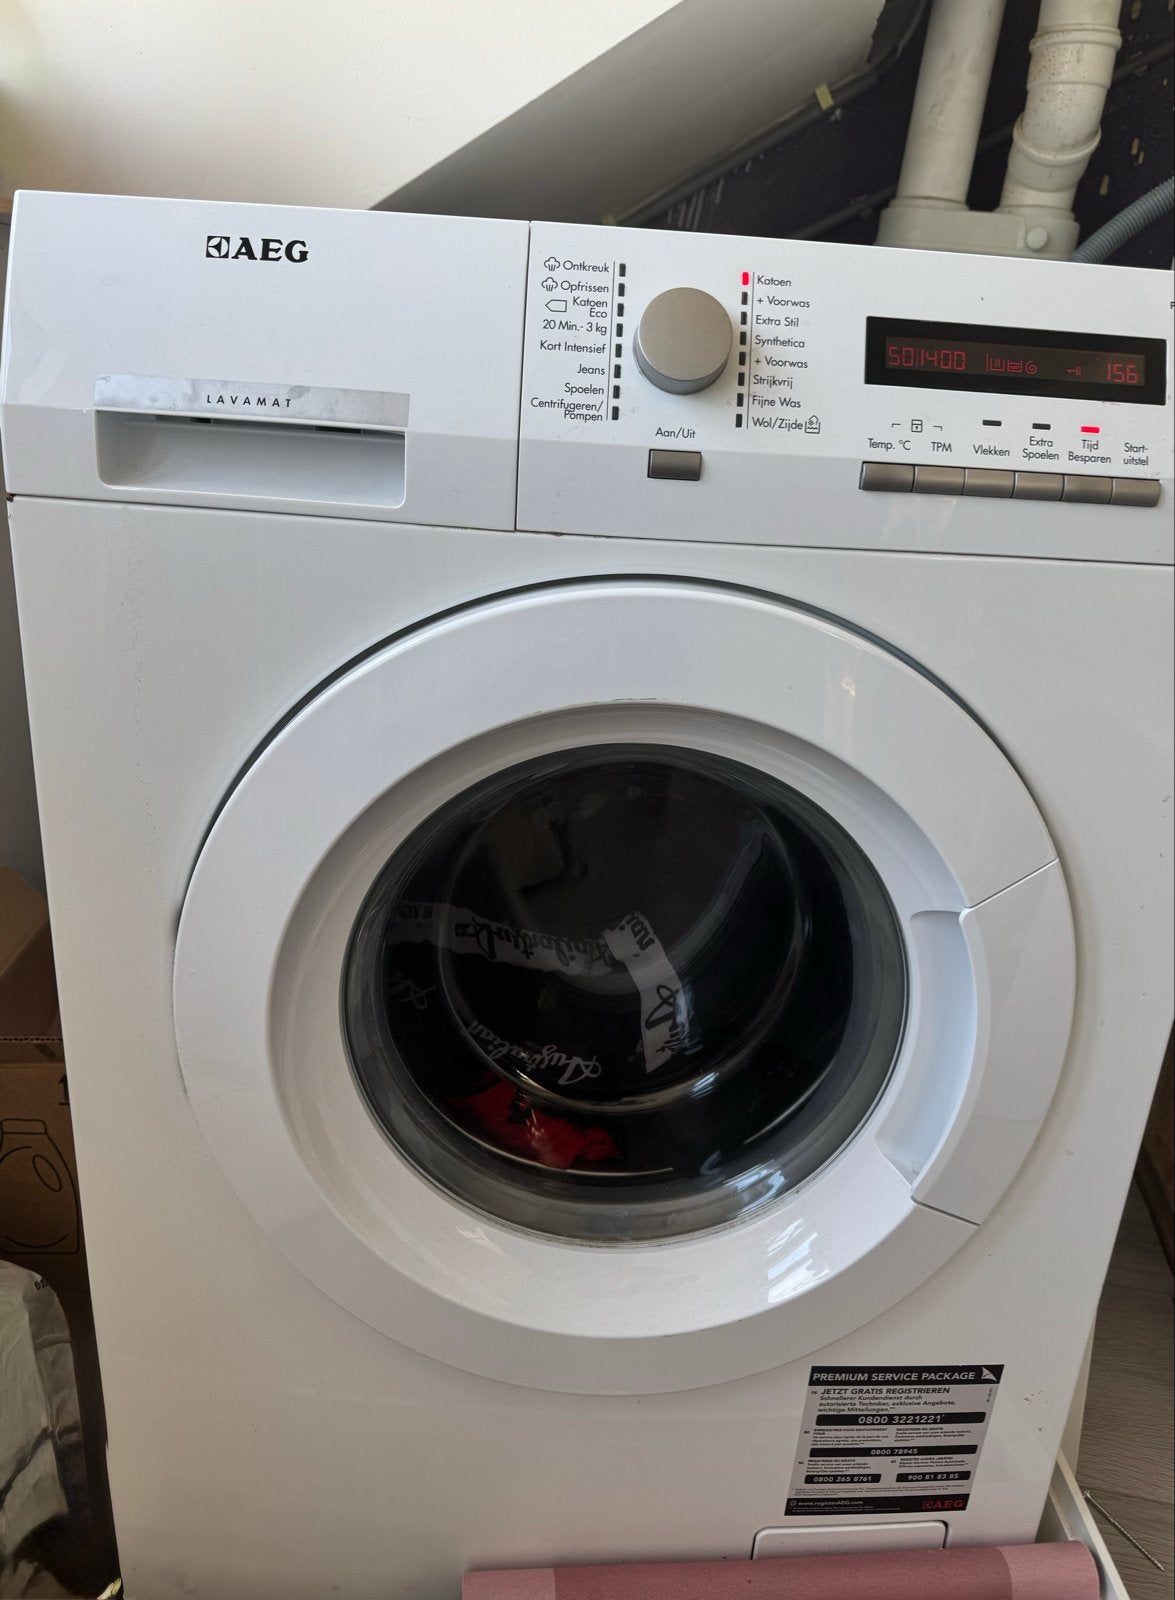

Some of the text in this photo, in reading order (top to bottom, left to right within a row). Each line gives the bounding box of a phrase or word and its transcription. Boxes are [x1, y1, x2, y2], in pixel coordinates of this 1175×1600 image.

[231, 237, 309, 263] AEG
[563, 260, 610, 273] Ontkreuk
[560, 280, 609, 293] Opfrissen
[757, 275, 792, 288] Katoen
[572, 297, 608, 308] Katoen
[767, 296, 811, 308] Voorwas
[589, 308, 608, 318] Eco
[542, 319, 556, 330] 20
[586, 322, 594, 332] 3
[595, 323, 607, 336] kg
[755, 316, 799, 327] Extra Stil
[540, 340, 606, 354] Kort Intensief
[754, 335, 806, 350] Synthetica
[764, 356, 809, 369] Voorwas
[577, 364, 606, 376] Jeans
[1105, 363, 1140, 384] 156
[752, 375, 793, 390] Strijkvrij
[564, 383, 605, 396] Spoelen
[206, 394, 292, 409] LAVAMAT
[530, 397, 604, 412] Centrifugeren/
[752, 395, 802, 409] Fijne Was
[564, 410, 604, 423] Pompen
[752, 417, 803, 432] Wol/Zijde
[655, 427, 696, 440] Aan/Uit
[867, 438, 911, 451] Temp. °C
[931, 442, 952, 453] TPM
[1029, 437, 1053, 448] Extra
[1080, 439, 1099, 452] Tijd
[1124, 443, 1149, 455] Start-
[973, 445, 1010, 457] Vlekken
[1022, 448, 1060, 462] Spoelen
[1068, 451, 1112, 466] Besparen
[1123, 455, 1149, 466] uitstel
[467, 1019, 602, 1086] Australian
[812, 1371, 975, 1382] PREMIUM SERVICE PACKAGE
[858, 1416, 888, 1424] 0800
[933, 1500, 964, 1509] AEG
